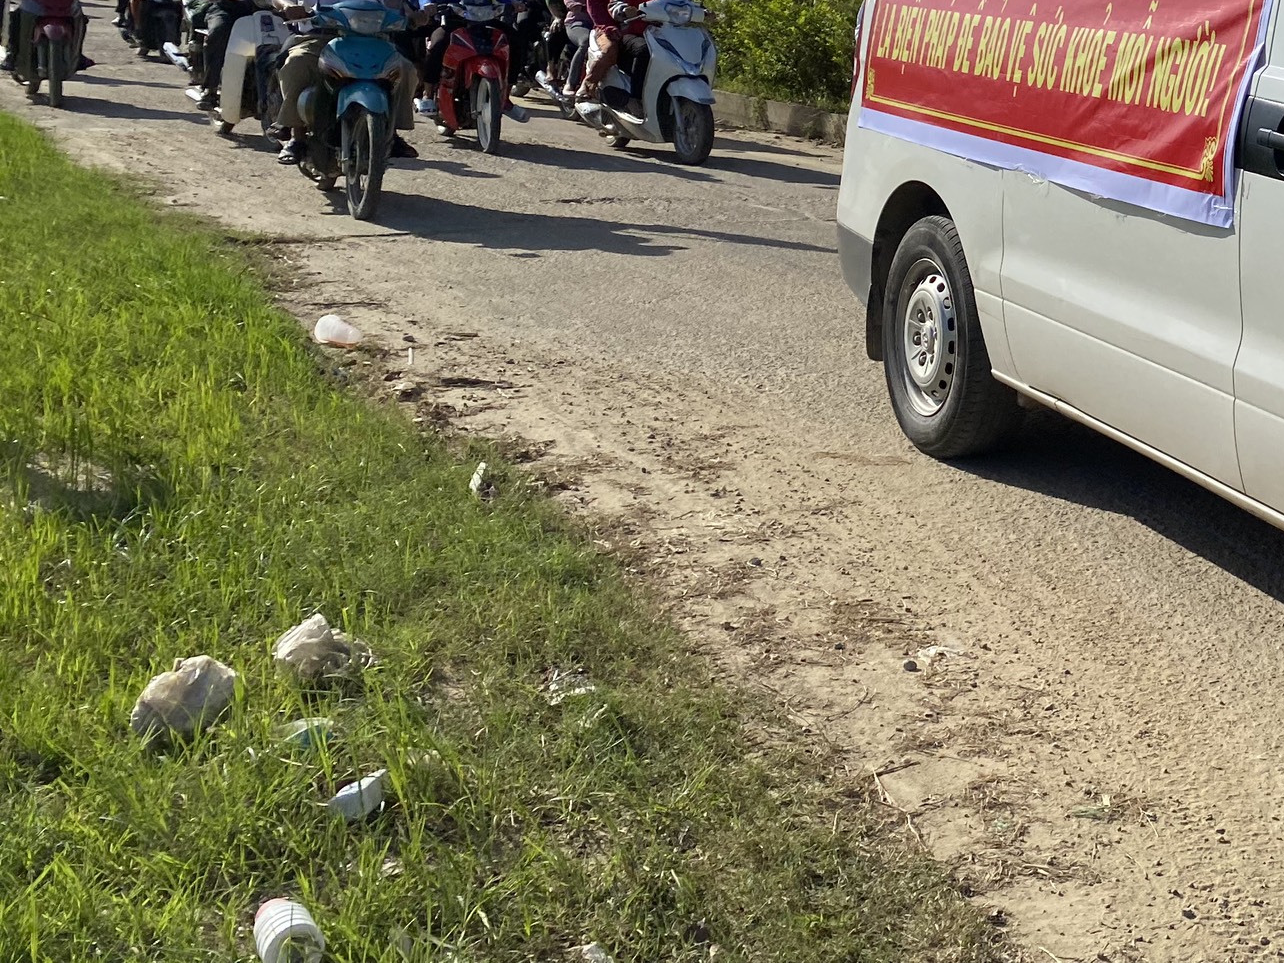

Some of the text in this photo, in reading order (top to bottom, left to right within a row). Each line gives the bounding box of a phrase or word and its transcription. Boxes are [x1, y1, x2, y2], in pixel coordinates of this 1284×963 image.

[1005, 3, 1037, 98] VỆ
[1027, 5, 1067, 90] SỨC
[1059, 2, 1117, 98] KHỎE
[1107, 0, 1159, 106] MỖI
[1145, 20, 1227, 118] NGƯỜI!
